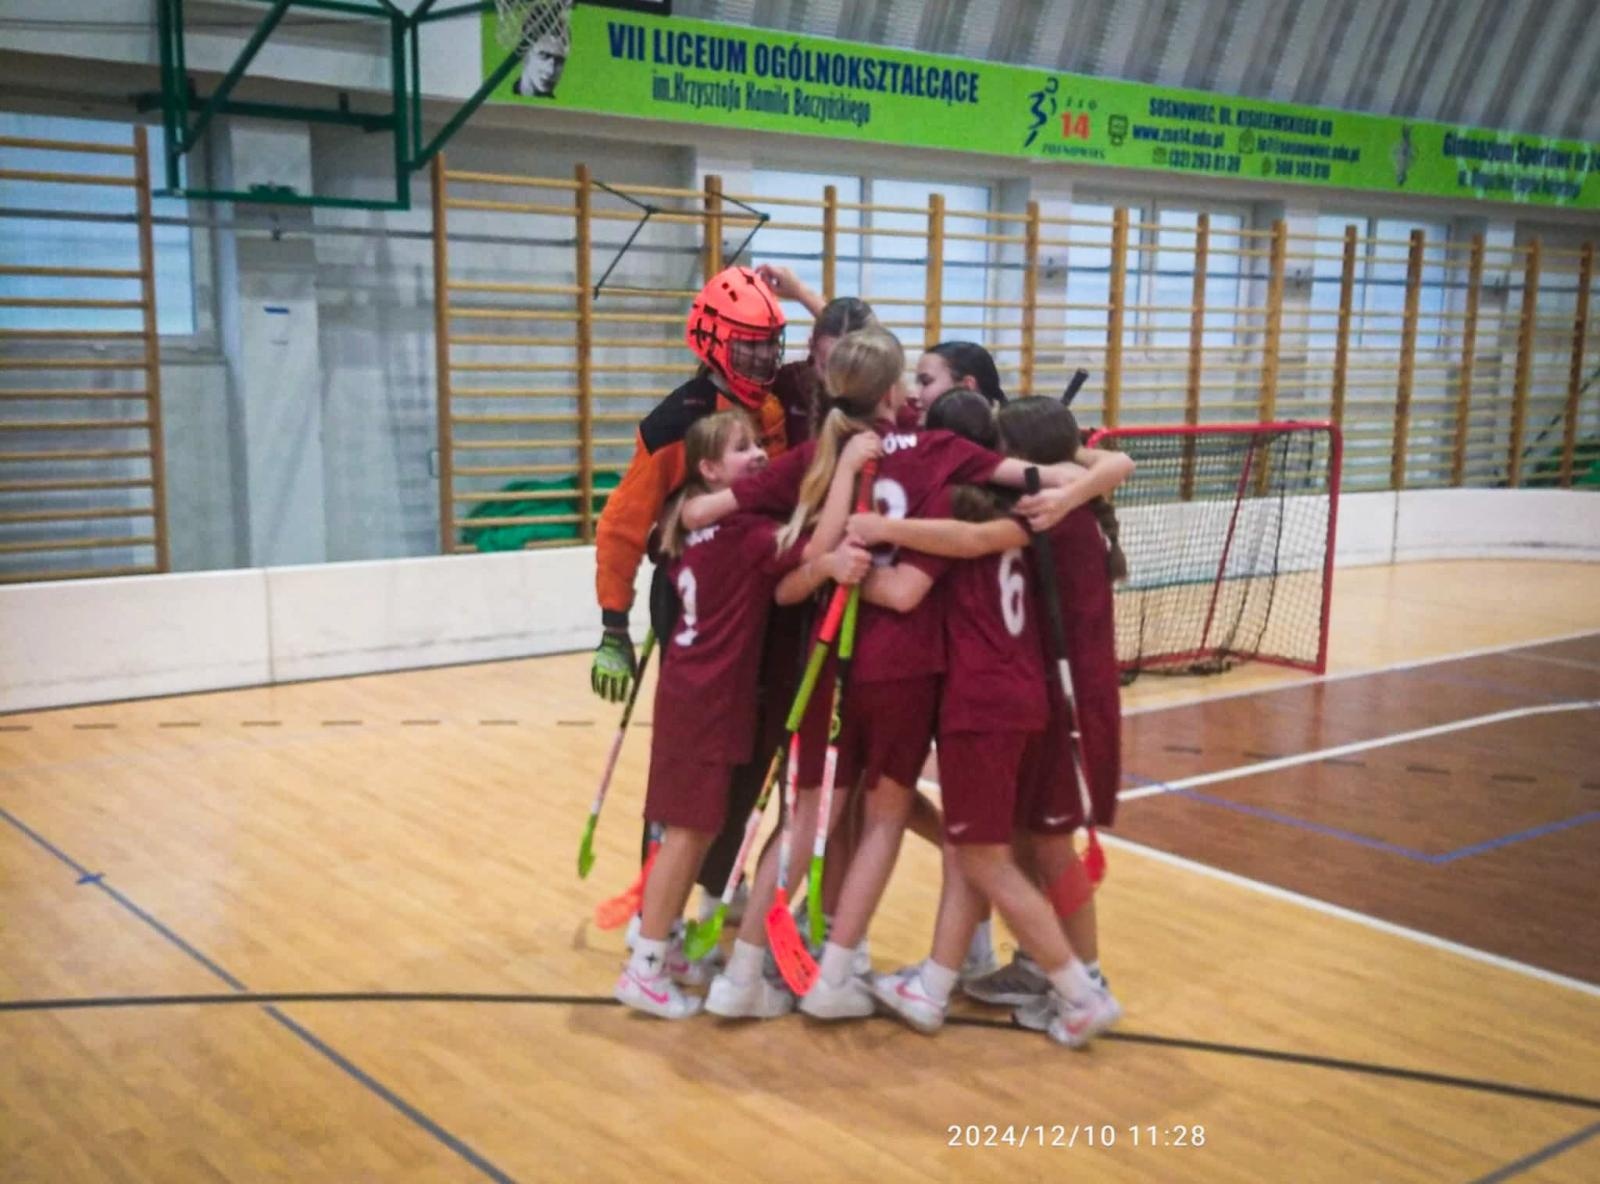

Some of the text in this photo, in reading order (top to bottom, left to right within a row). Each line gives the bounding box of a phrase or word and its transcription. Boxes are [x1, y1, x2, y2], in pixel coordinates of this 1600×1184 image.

[608, 22, 980, 106] VII LICEUM OGÓLNOKSZTAŁCĄCE
[1061, 111, 1090, 140] 14
[998, 547, 1026, 638] 6
